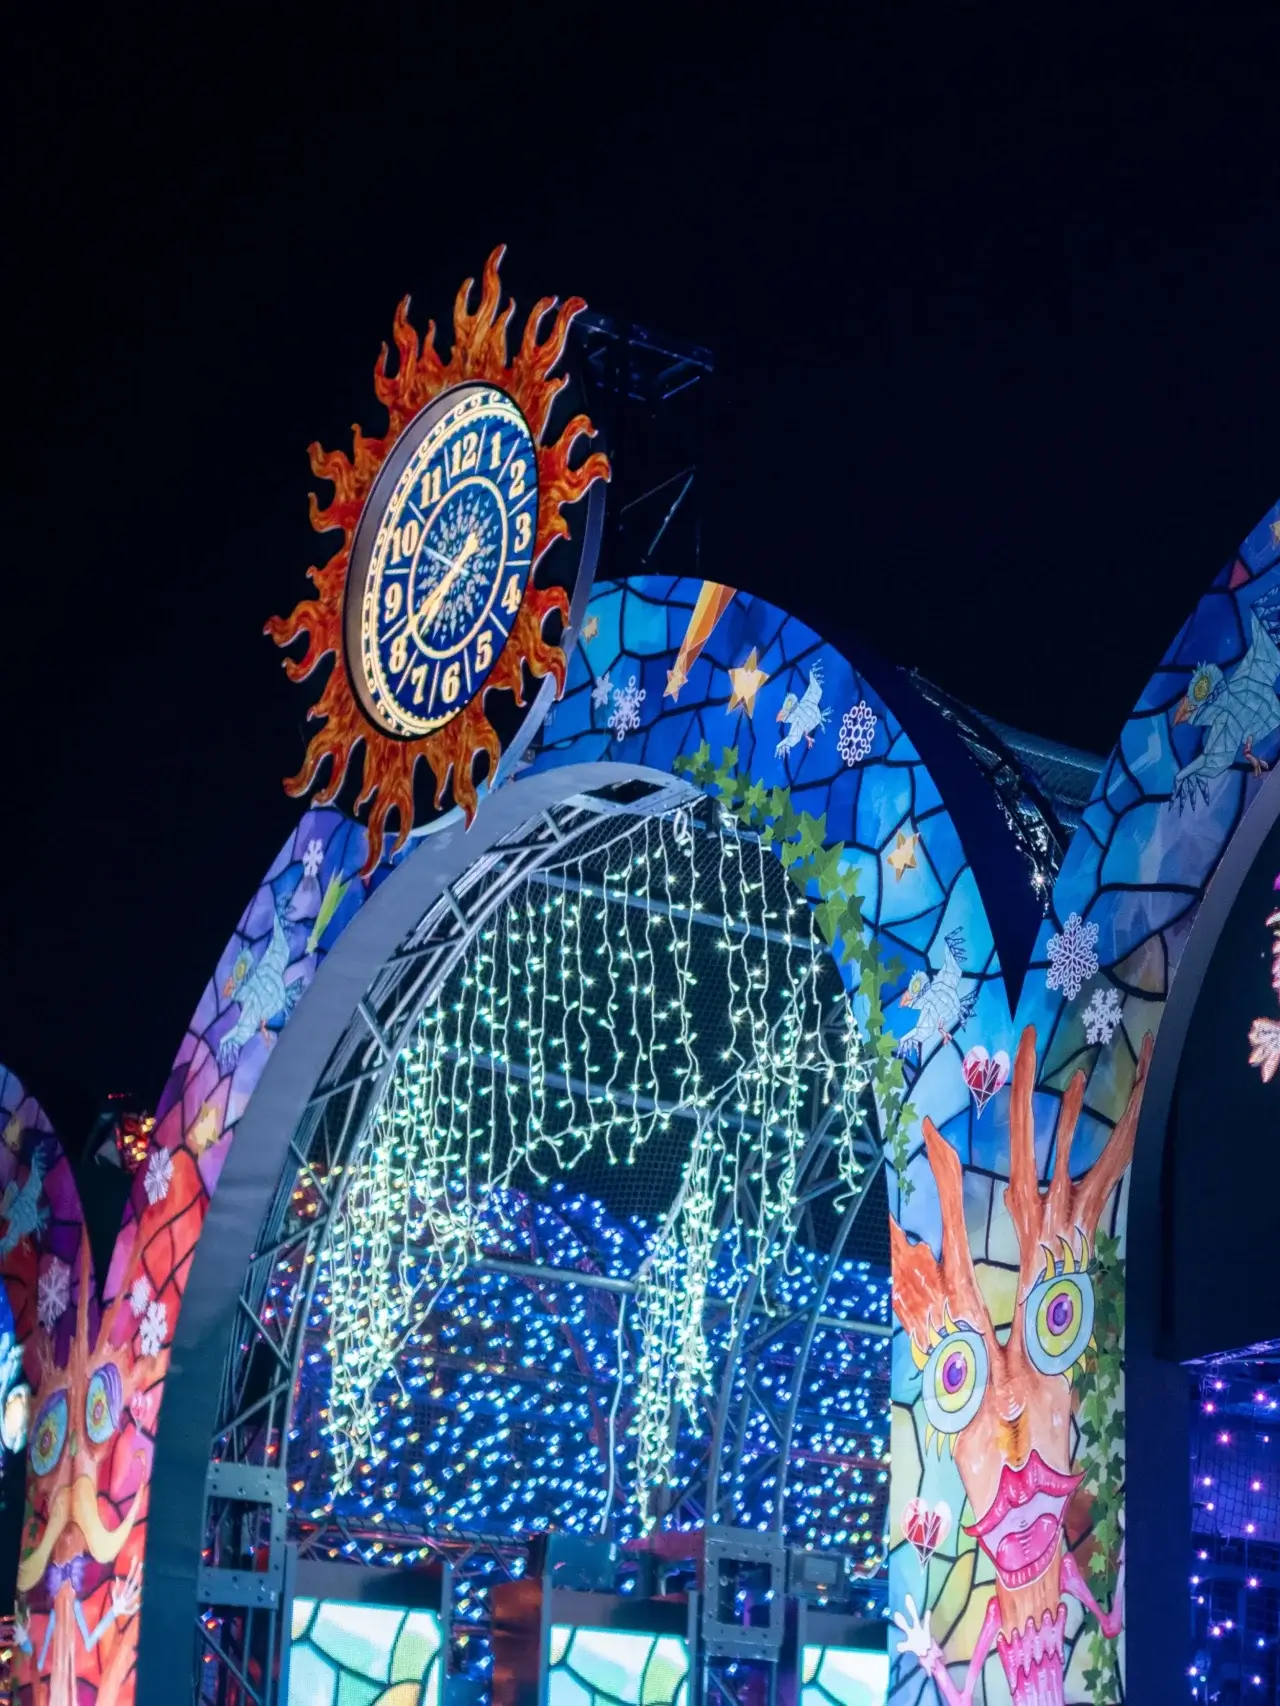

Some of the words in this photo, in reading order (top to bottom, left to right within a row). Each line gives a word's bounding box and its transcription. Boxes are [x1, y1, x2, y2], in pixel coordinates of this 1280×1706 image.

[450, 431, 479, 476] 12
[488, 431, 502, 471] 1
[419, 465, 442, 510] 11
[509, 459, 526, 500] 2
[389, 520, 420, 566] 10
[514, 511, 531, 553] 3
[384, 582, 403, 623] 9
[501, 573, 522, 615] 4
[388, 635, 408, 675] 8
[475, 630, 494, 670] 5
[411, 664, 429, 706] 7
[441, 661, 460, 704] 6
